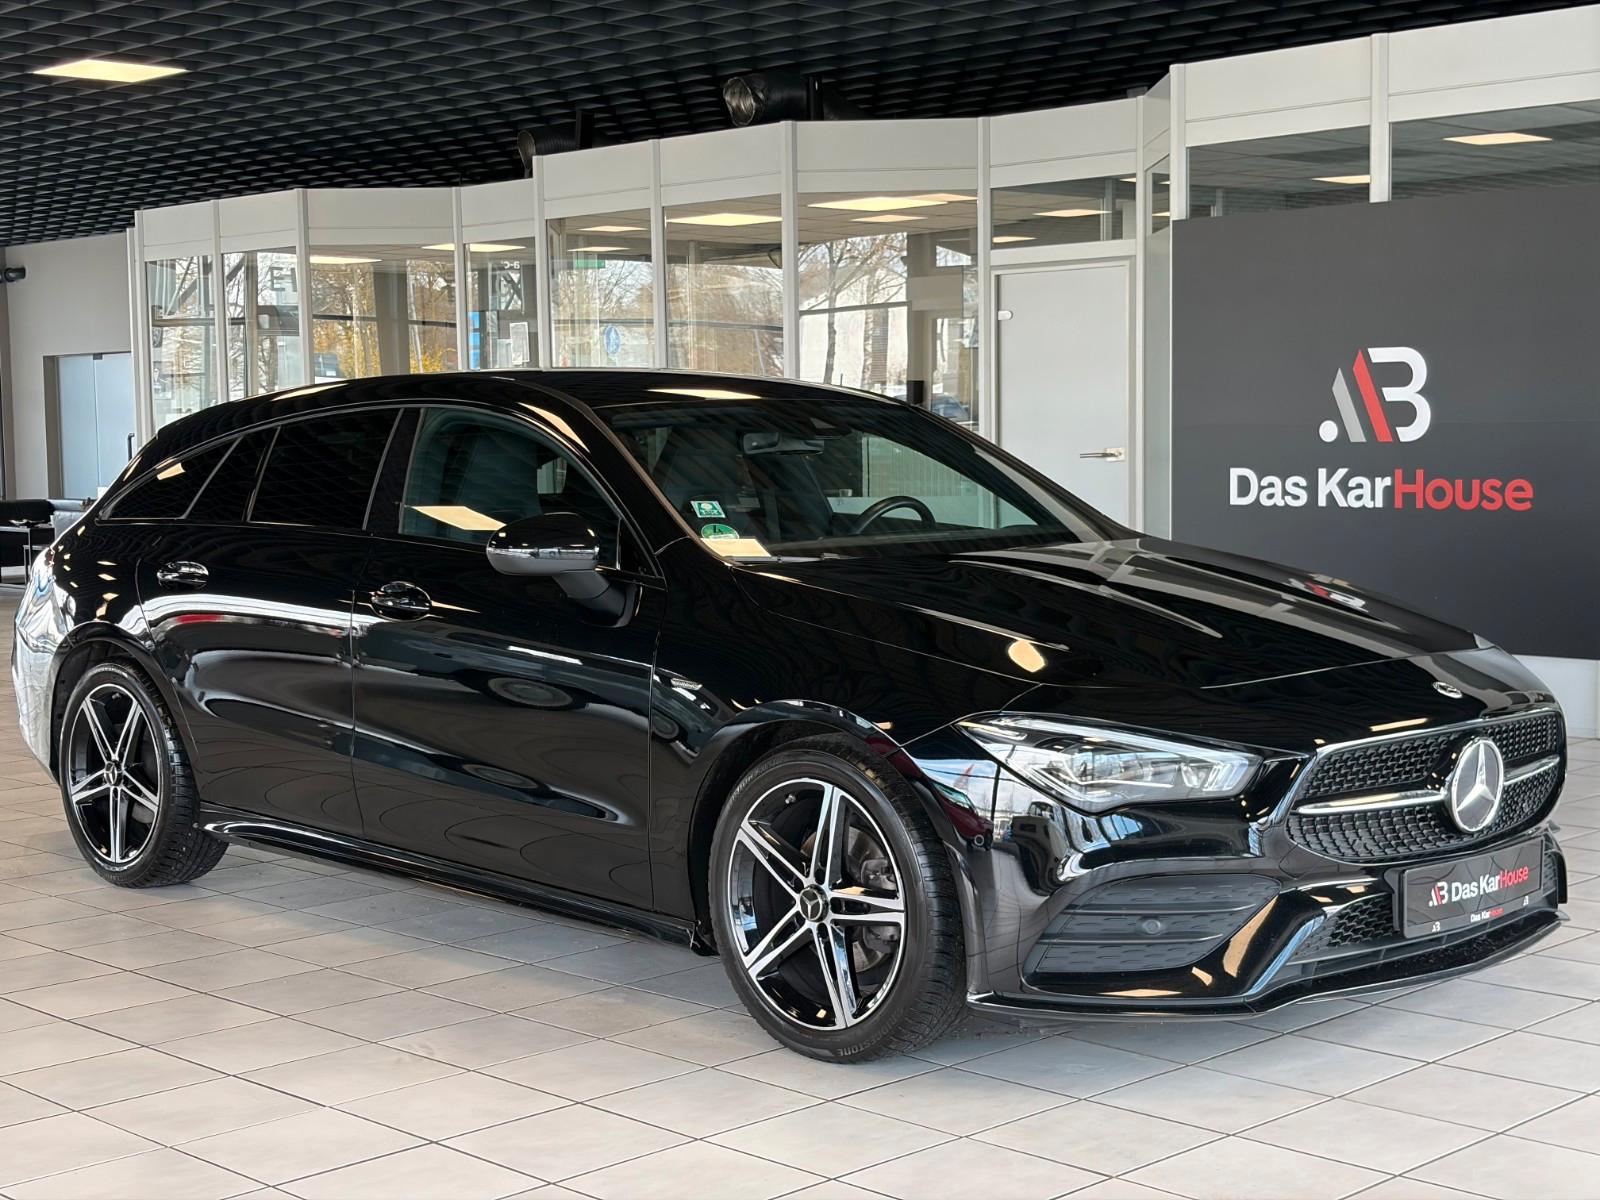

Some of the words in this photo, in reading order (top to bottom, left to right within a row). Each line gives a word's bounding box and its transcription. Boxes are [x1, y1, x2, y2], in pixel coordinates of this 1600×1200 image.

[1229, 467, 1308, 508] Das
[1317, 467, 1534, 511] KarHouse
[1451, 881, 1478, 902] Das
[1480, 866, 1529, 895] KarHouse
